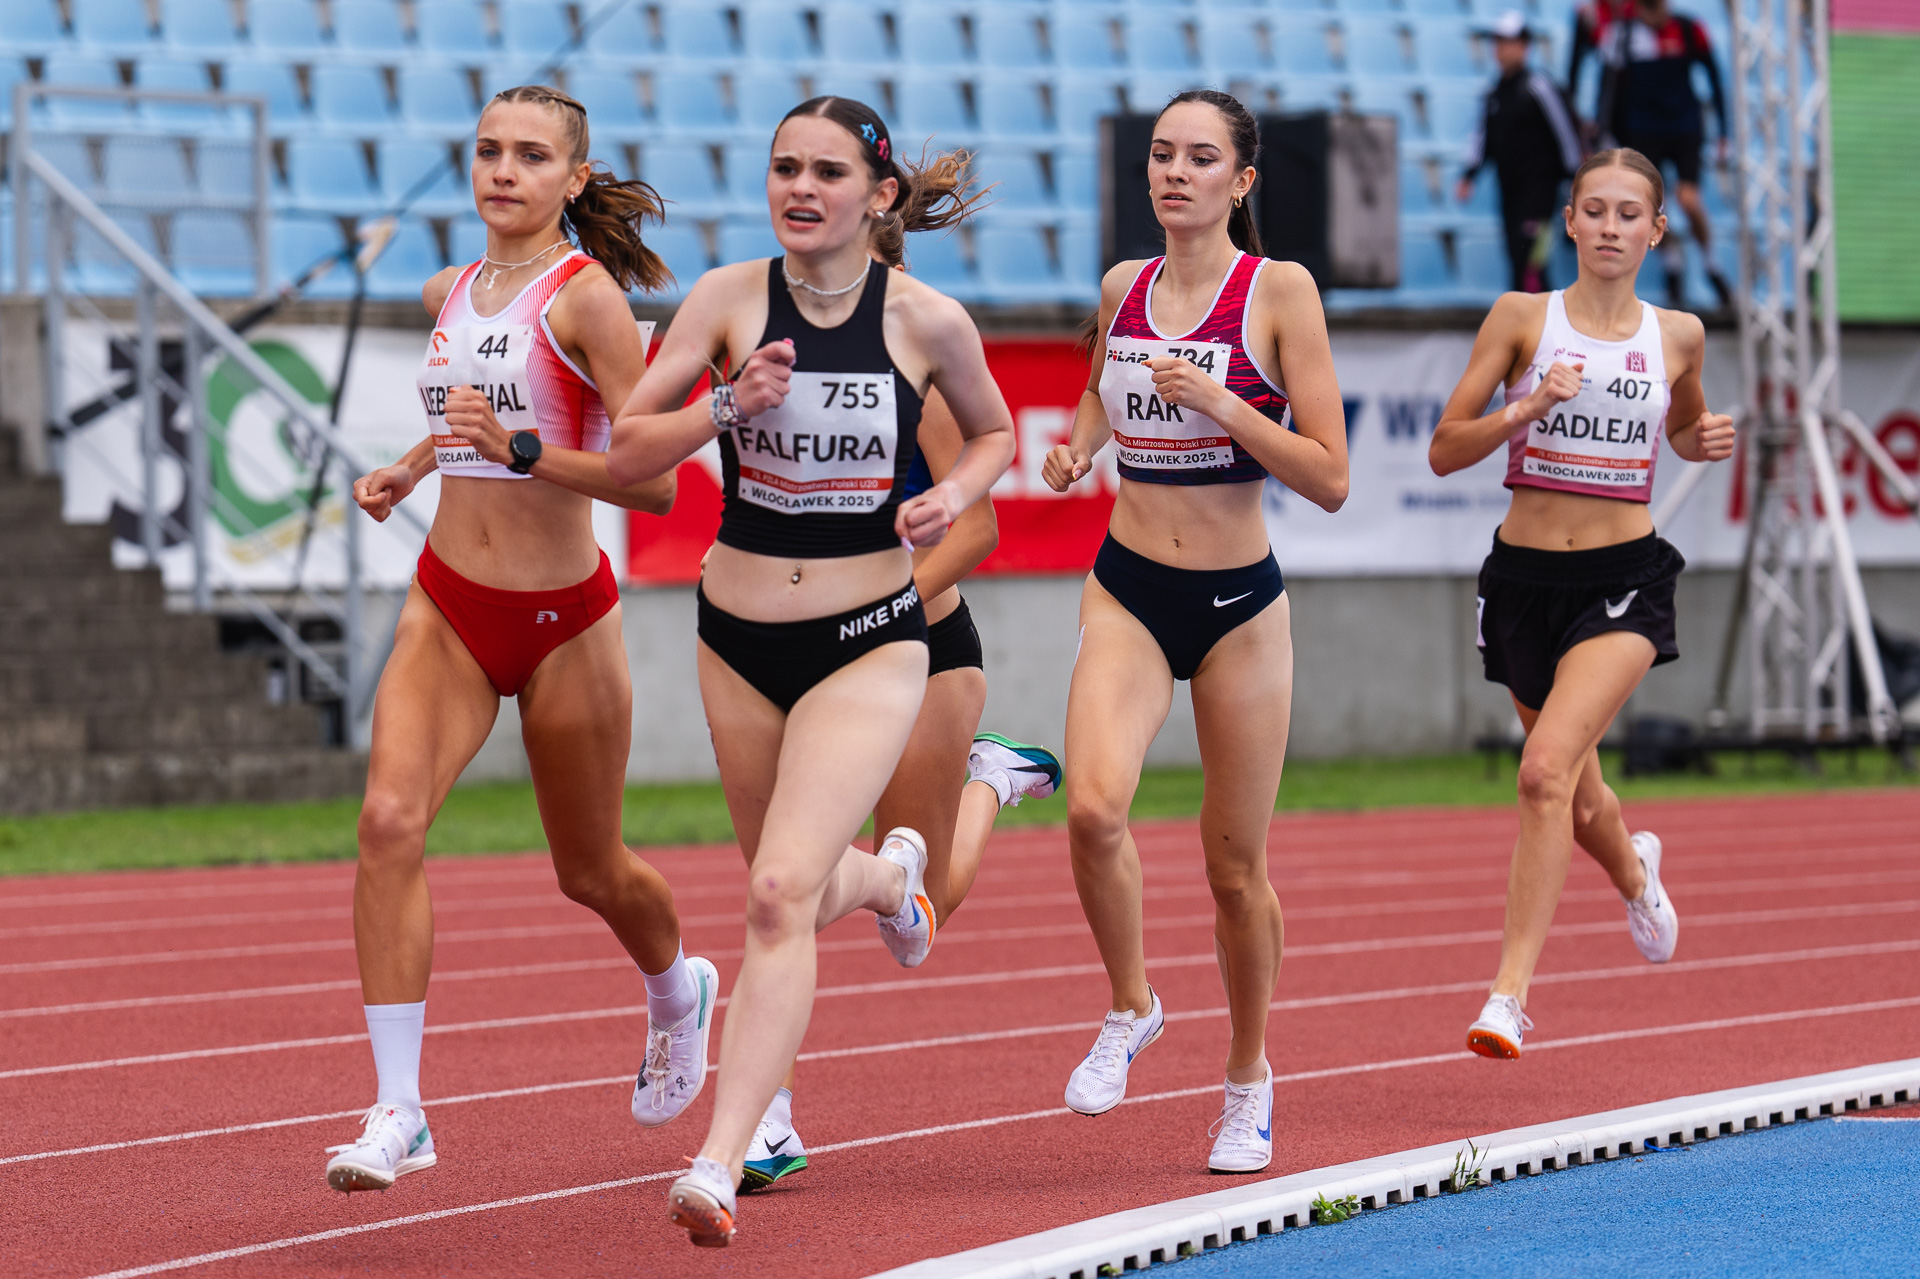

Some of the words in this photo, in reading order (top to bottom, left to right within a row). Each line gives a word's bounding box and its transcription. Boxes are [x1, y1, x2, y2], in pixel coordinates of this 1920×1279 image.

[477, 334, 509, 359] 44
[1107, 349, 1149, 363] POLAR
[420, 383, 527, 416] LIEBHAL
[822, 381, 880, 409] 755
[1607, 377, 1652, 401] 407
[1127, 392, 1184, 423] RAK
[1536, 412, 1647, 444] SADLEJA
[737, 426, 887, 463] FALFURA
[1132, 439, 1175, 449] Mistrzostwa
[1175, 440, 1200, 449] Polski
[1201, 438, 1218, 446] U20
[1119, 447, 1182, 465] WŁOCŁAWEK
[1183, 451, 1217, 464] 2025
[1564, 455, 1608, 467] Mistrzostwa
[831, 479, 858, 488] Polski
[859, 479, 879, 489] U20
[1537, 463, 1611, 481] WŁOCŁAWEK
[1613, 472, 1637, 482] 2025
[751, 486, 835, 508] WŁOCŁAWEK
[838, 495, 875, 507] 2025
[839, 605, 890, 641] NIKE
[891, 584, 918, 618] PRO
